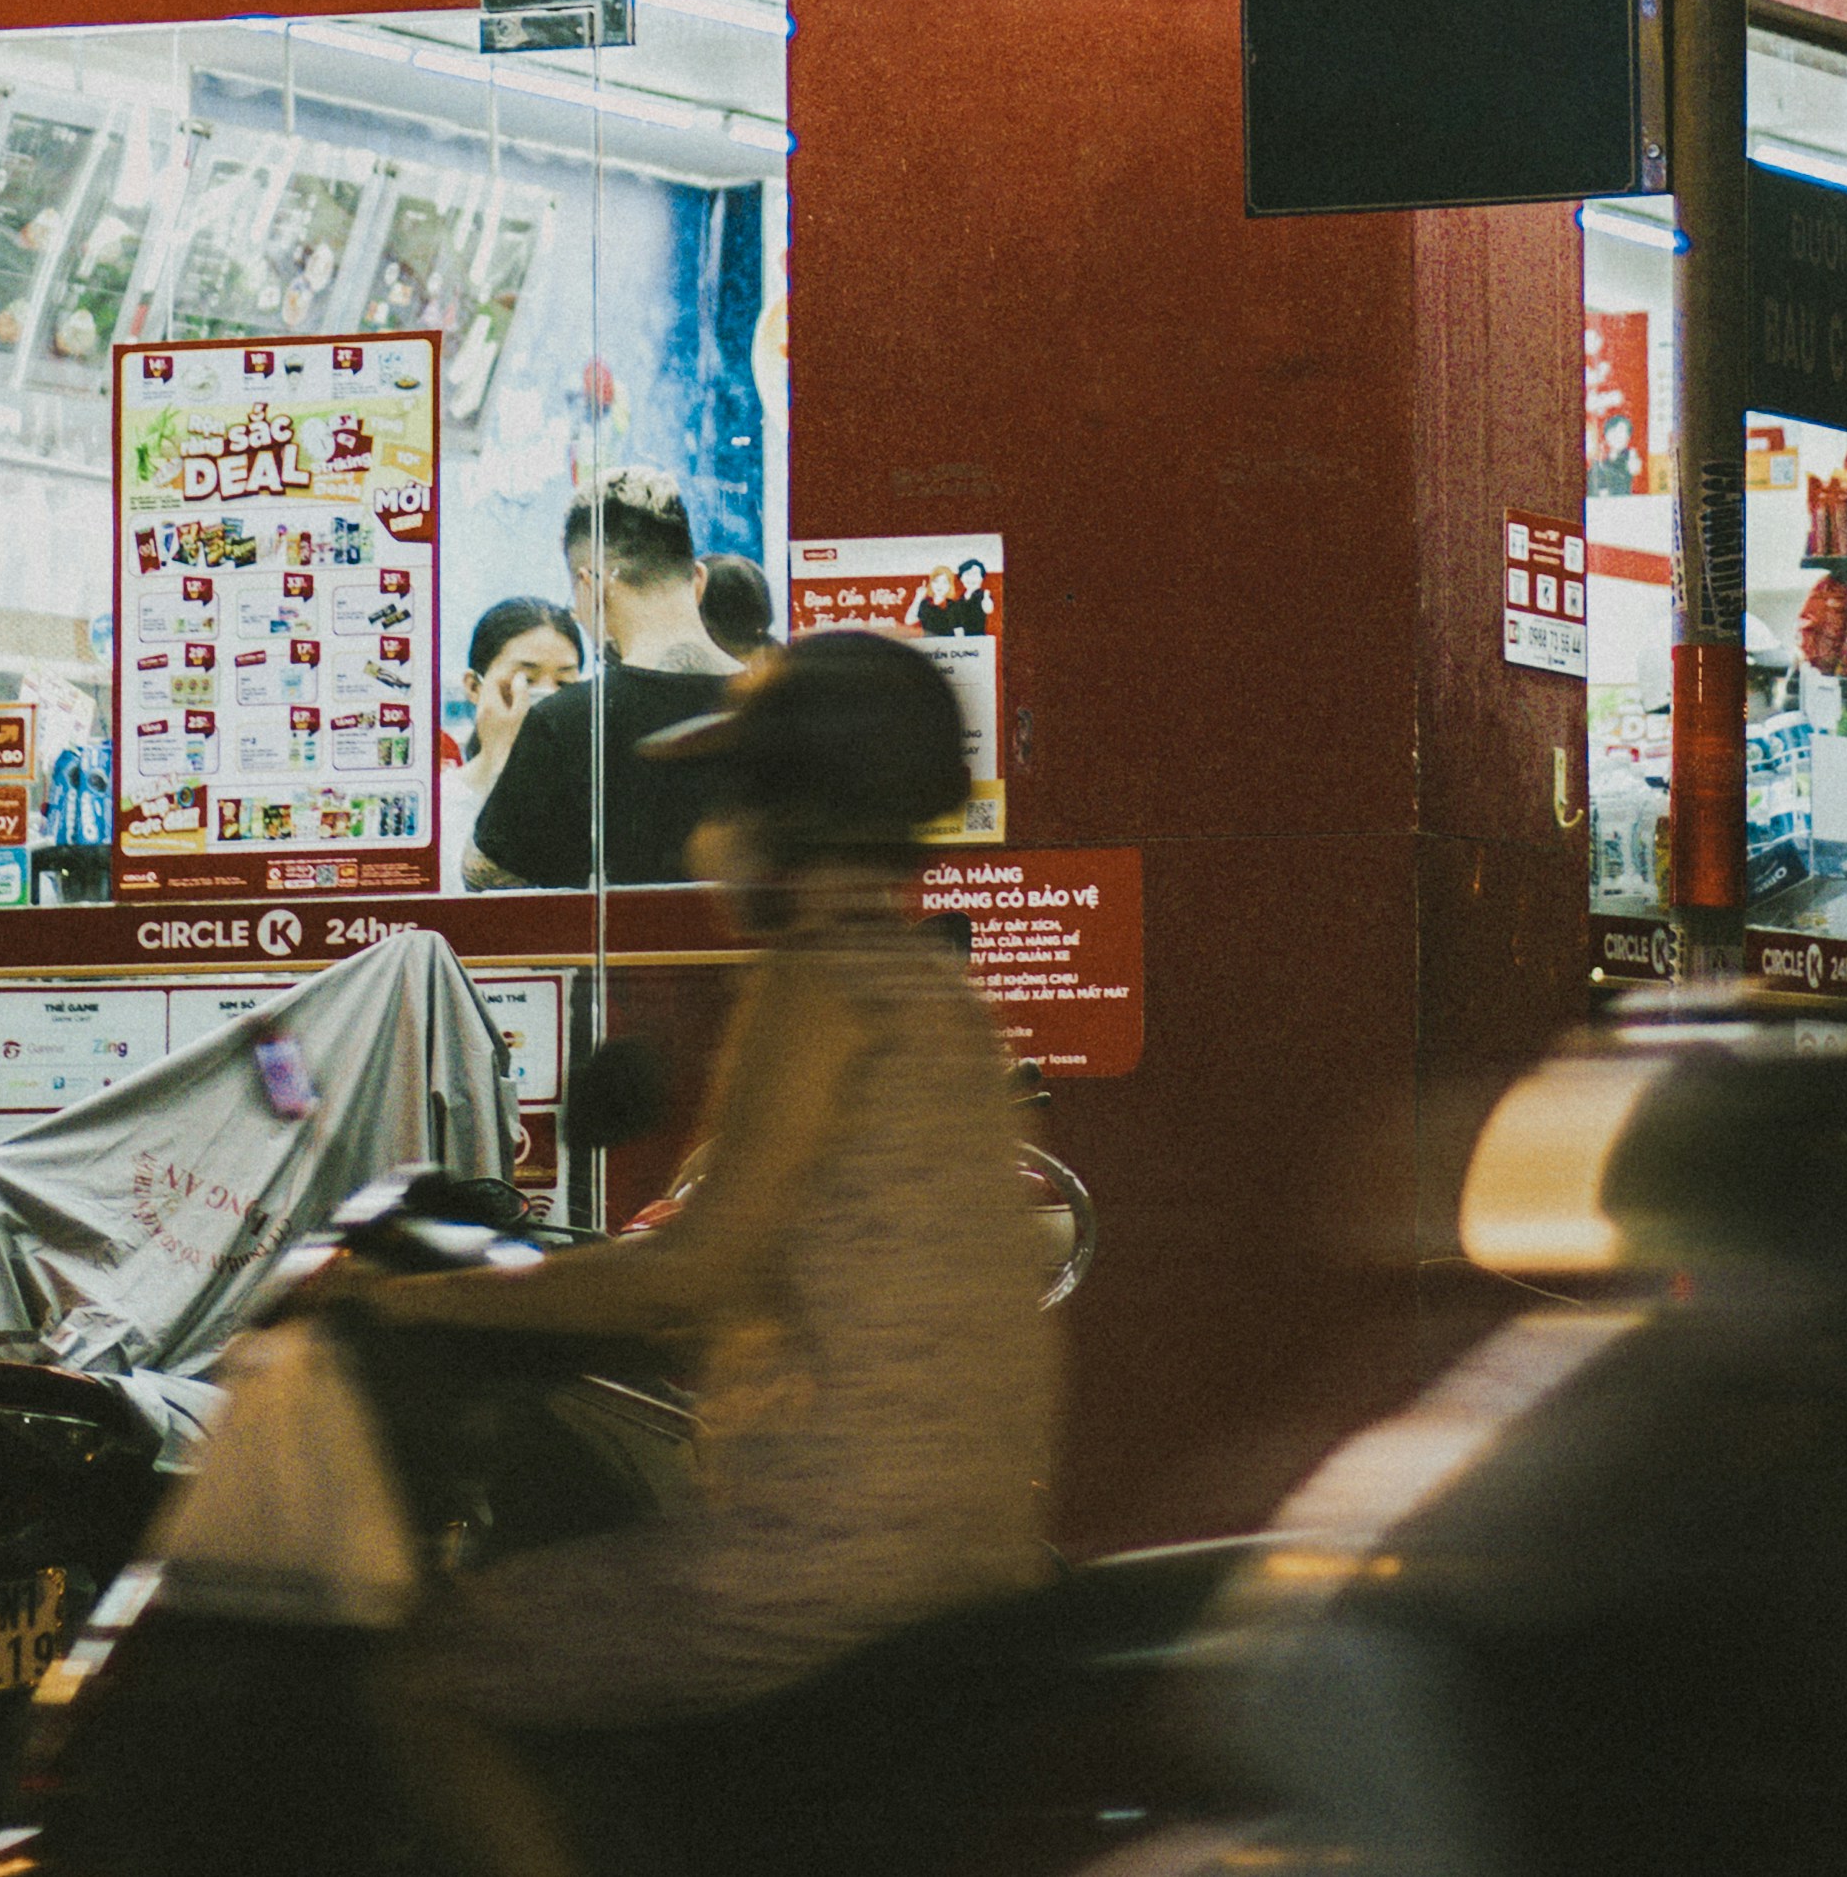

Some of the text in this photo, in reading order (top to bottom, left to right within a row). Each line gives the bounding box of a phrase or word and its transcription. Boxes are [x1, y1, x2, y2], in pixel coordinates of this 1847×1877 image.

[184, 444, 310, 500] DEAL
[374, 480, 430, 512] MỚI
[804, 589, 834, 611] Bạn
[923, 862, 1023, 885] CỬA HÀNG
[923, 884, 1099, 910] KHÔNG CÓ BẢO VỆ
[137, 920, 250, 949] CIRCLE
[1762, 948, 1804, 978] CIRCLE
[92, 1038, 129, 1058] Zing
